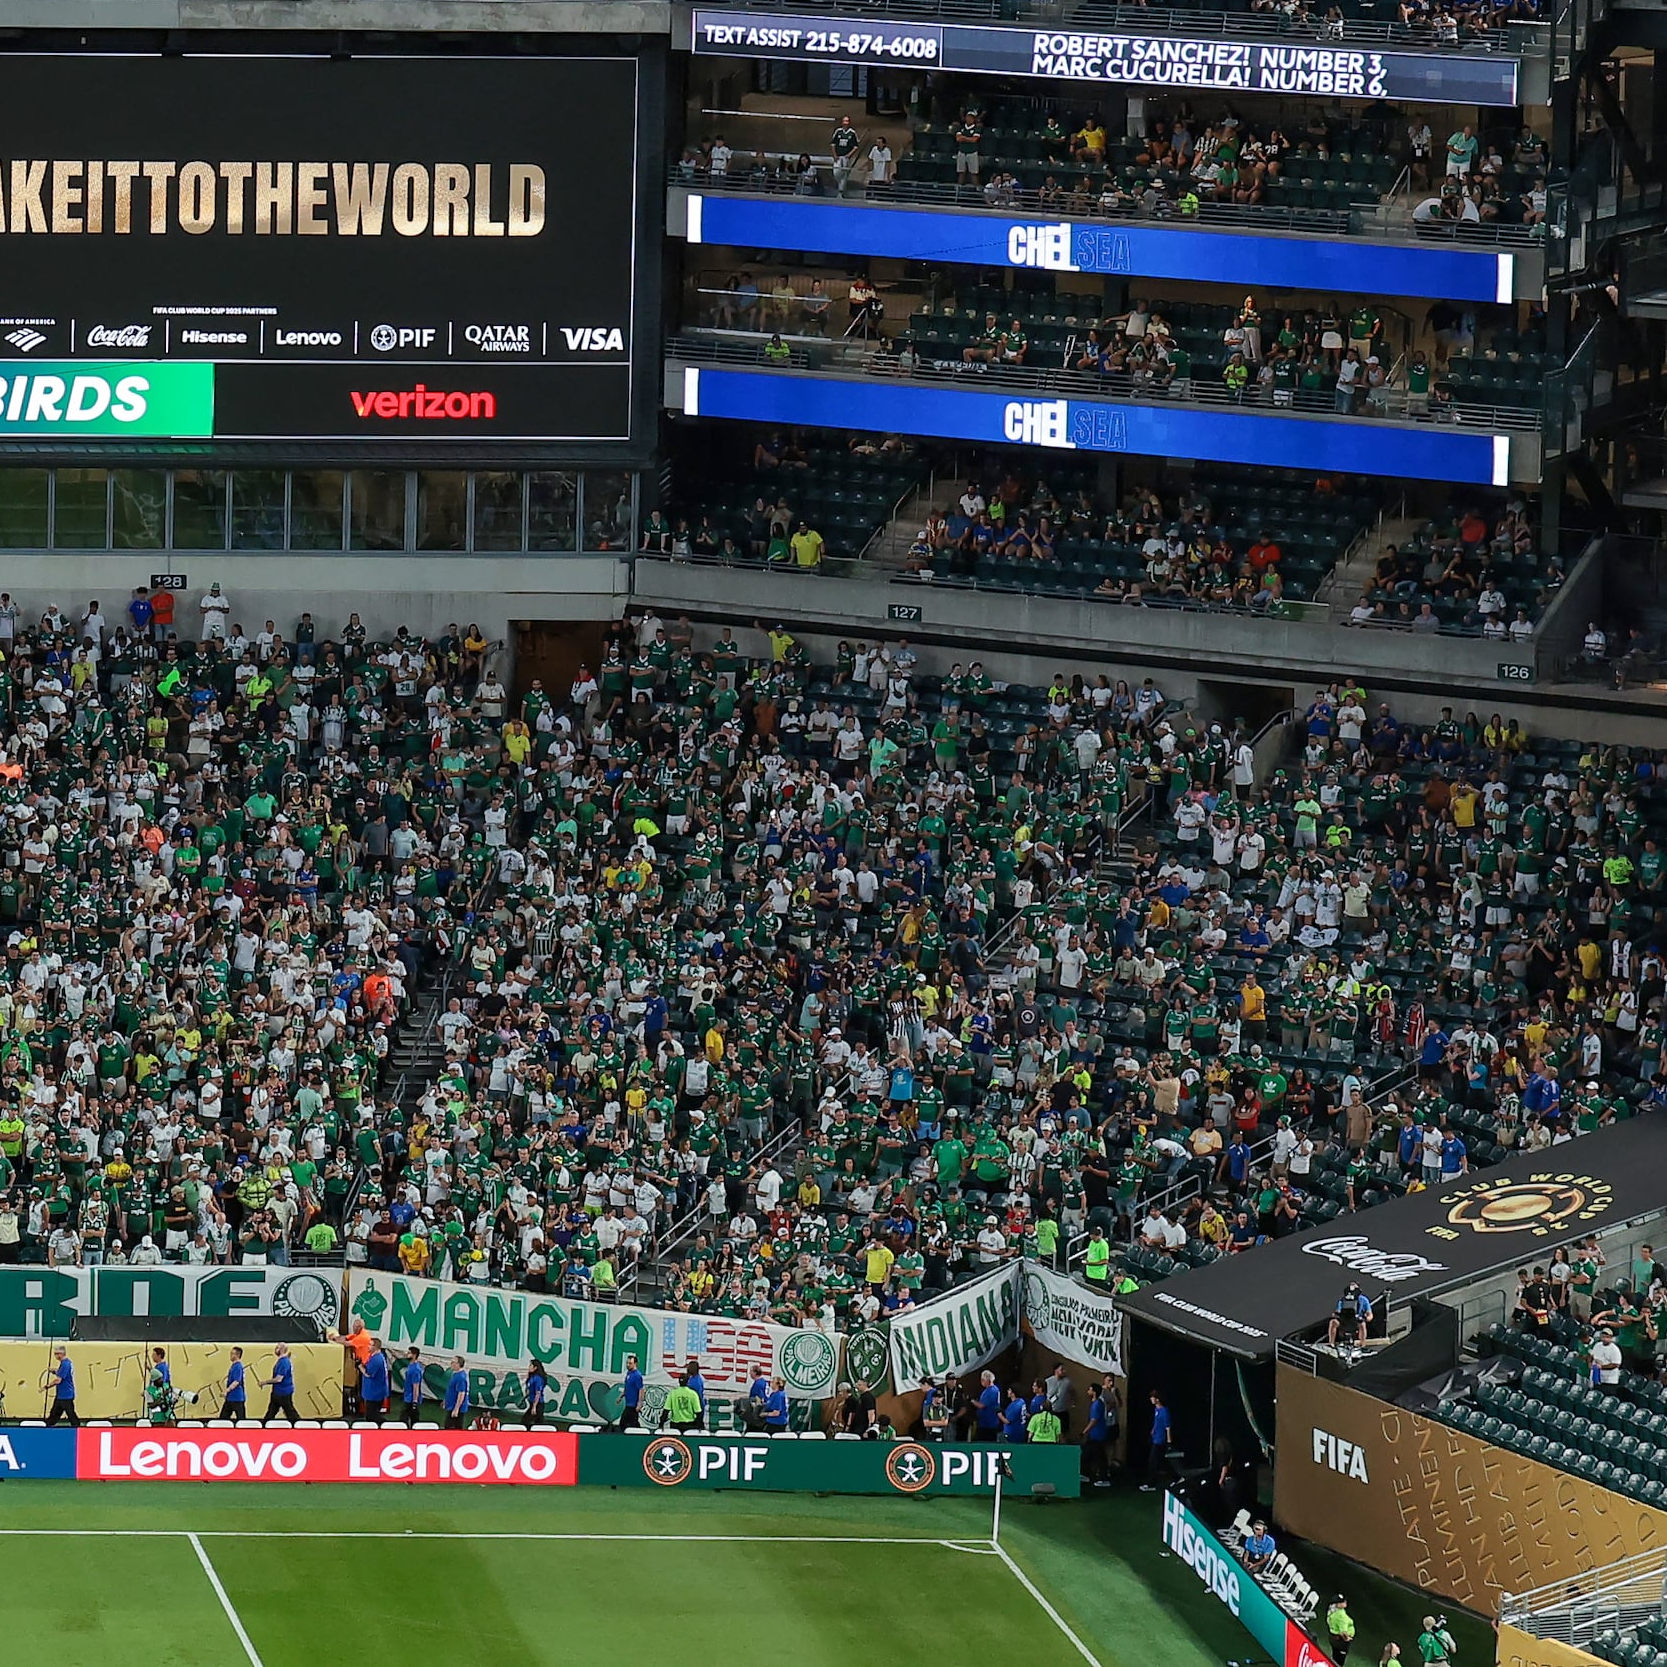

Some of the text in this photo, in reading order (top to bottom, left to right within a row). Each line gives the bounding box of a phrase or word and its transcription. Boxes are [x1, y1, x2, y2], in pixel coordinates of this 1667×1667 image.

[704, 24, 937, 59] TEXT ASSIST 215-874-6008
[1034, 34, 1387, 77] ROBERT SANCHEZ! NUMBER 3,
[1032, 54, 1388, 97] MARC CUCURELLA! NUMBER 6,
[1007, 222, 1131, 273] CHELSEA
[182, 330, 247, 344] Hisense
[276, 329, 342, 346] Lenovo
[399, 328, 436, 348] PIF
[465, 325, 529, 343] QATAR
[480, 342, 530, 352] AIRWAYS
[560, 328, 624, 351] VISA
[350, 384, 495, 419] verizon
[1004, 399, 1127, 449] CHELSEA
[892, 605, 917, 620] 127
[1501, 665, 1529, 679] 126
[1440, 1172, 1615, 1220] CLUB WORLD CUP
[1425, 1226, 1461, 1241] FIFA
[389, 1279, 653, 1376] MANCHA
[663, 1318, 773, 1382] USA
[785, 1347, 836, 1389] PALMEIRAS
[101, 1431, 308, 1478] Lenovo
[349, 1433, 556, 1479] Lenovo
[697, 1445, 768, 1482] PIF
[942, 1451, 1011, 1487] PIF
[1312, 1428, 1368, 1485] FIFA
[1163, 1492, 1240, 1617] Hisense
